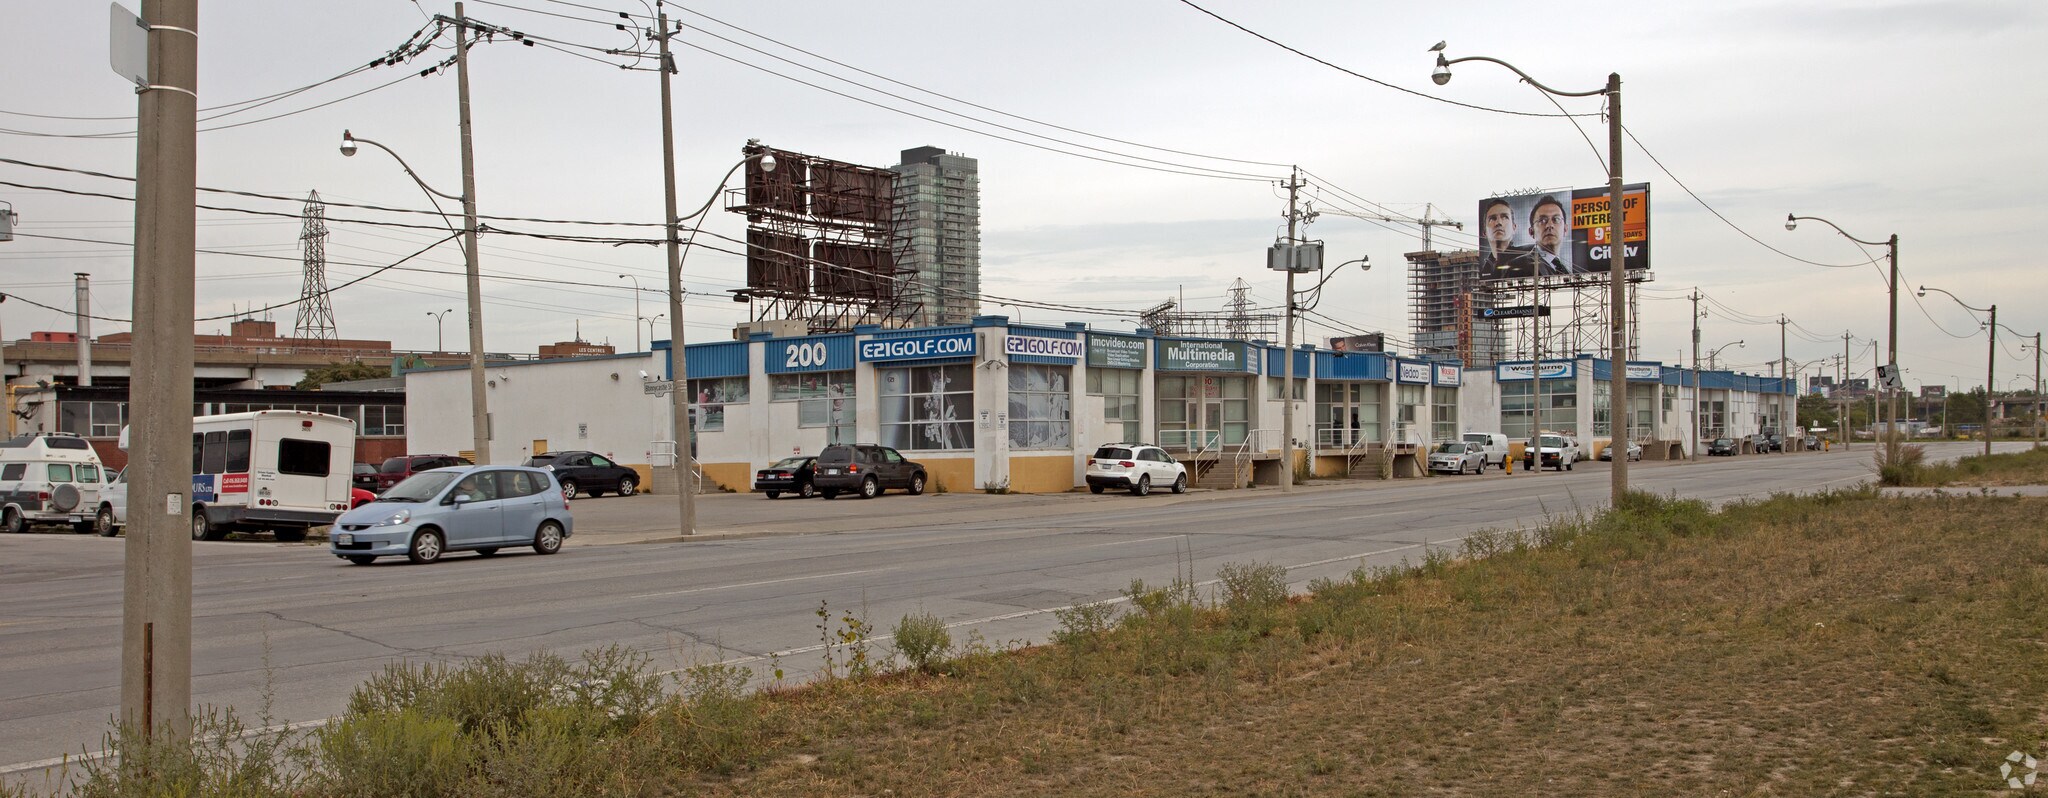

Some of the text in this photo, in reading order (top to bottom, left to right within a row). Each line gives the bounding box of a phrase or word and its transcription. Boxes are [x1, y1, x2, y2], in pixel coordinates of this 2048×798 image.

[1574, 198, 1638, 214] PERSO OF
[1574, 211, 1628, 226] INTERET
[1594, 227, 1604, 240] 9
[1605, 231, 1643, 240] TSDAYS
[1590, 245, 1639, 260] Cittv
[863, 338, 972, 358] E21GOLF.COM
[1007, 336, 1082, 356] E21GOLF.COM
[1091, 335, 1145, 349] imcvideo.com
[1181, 341, 1223, 349] International
[786, 342, 827, 367] 200
[1168, 347, 1235, 361] Multimedia
[192, 482, 206, 493] URS
